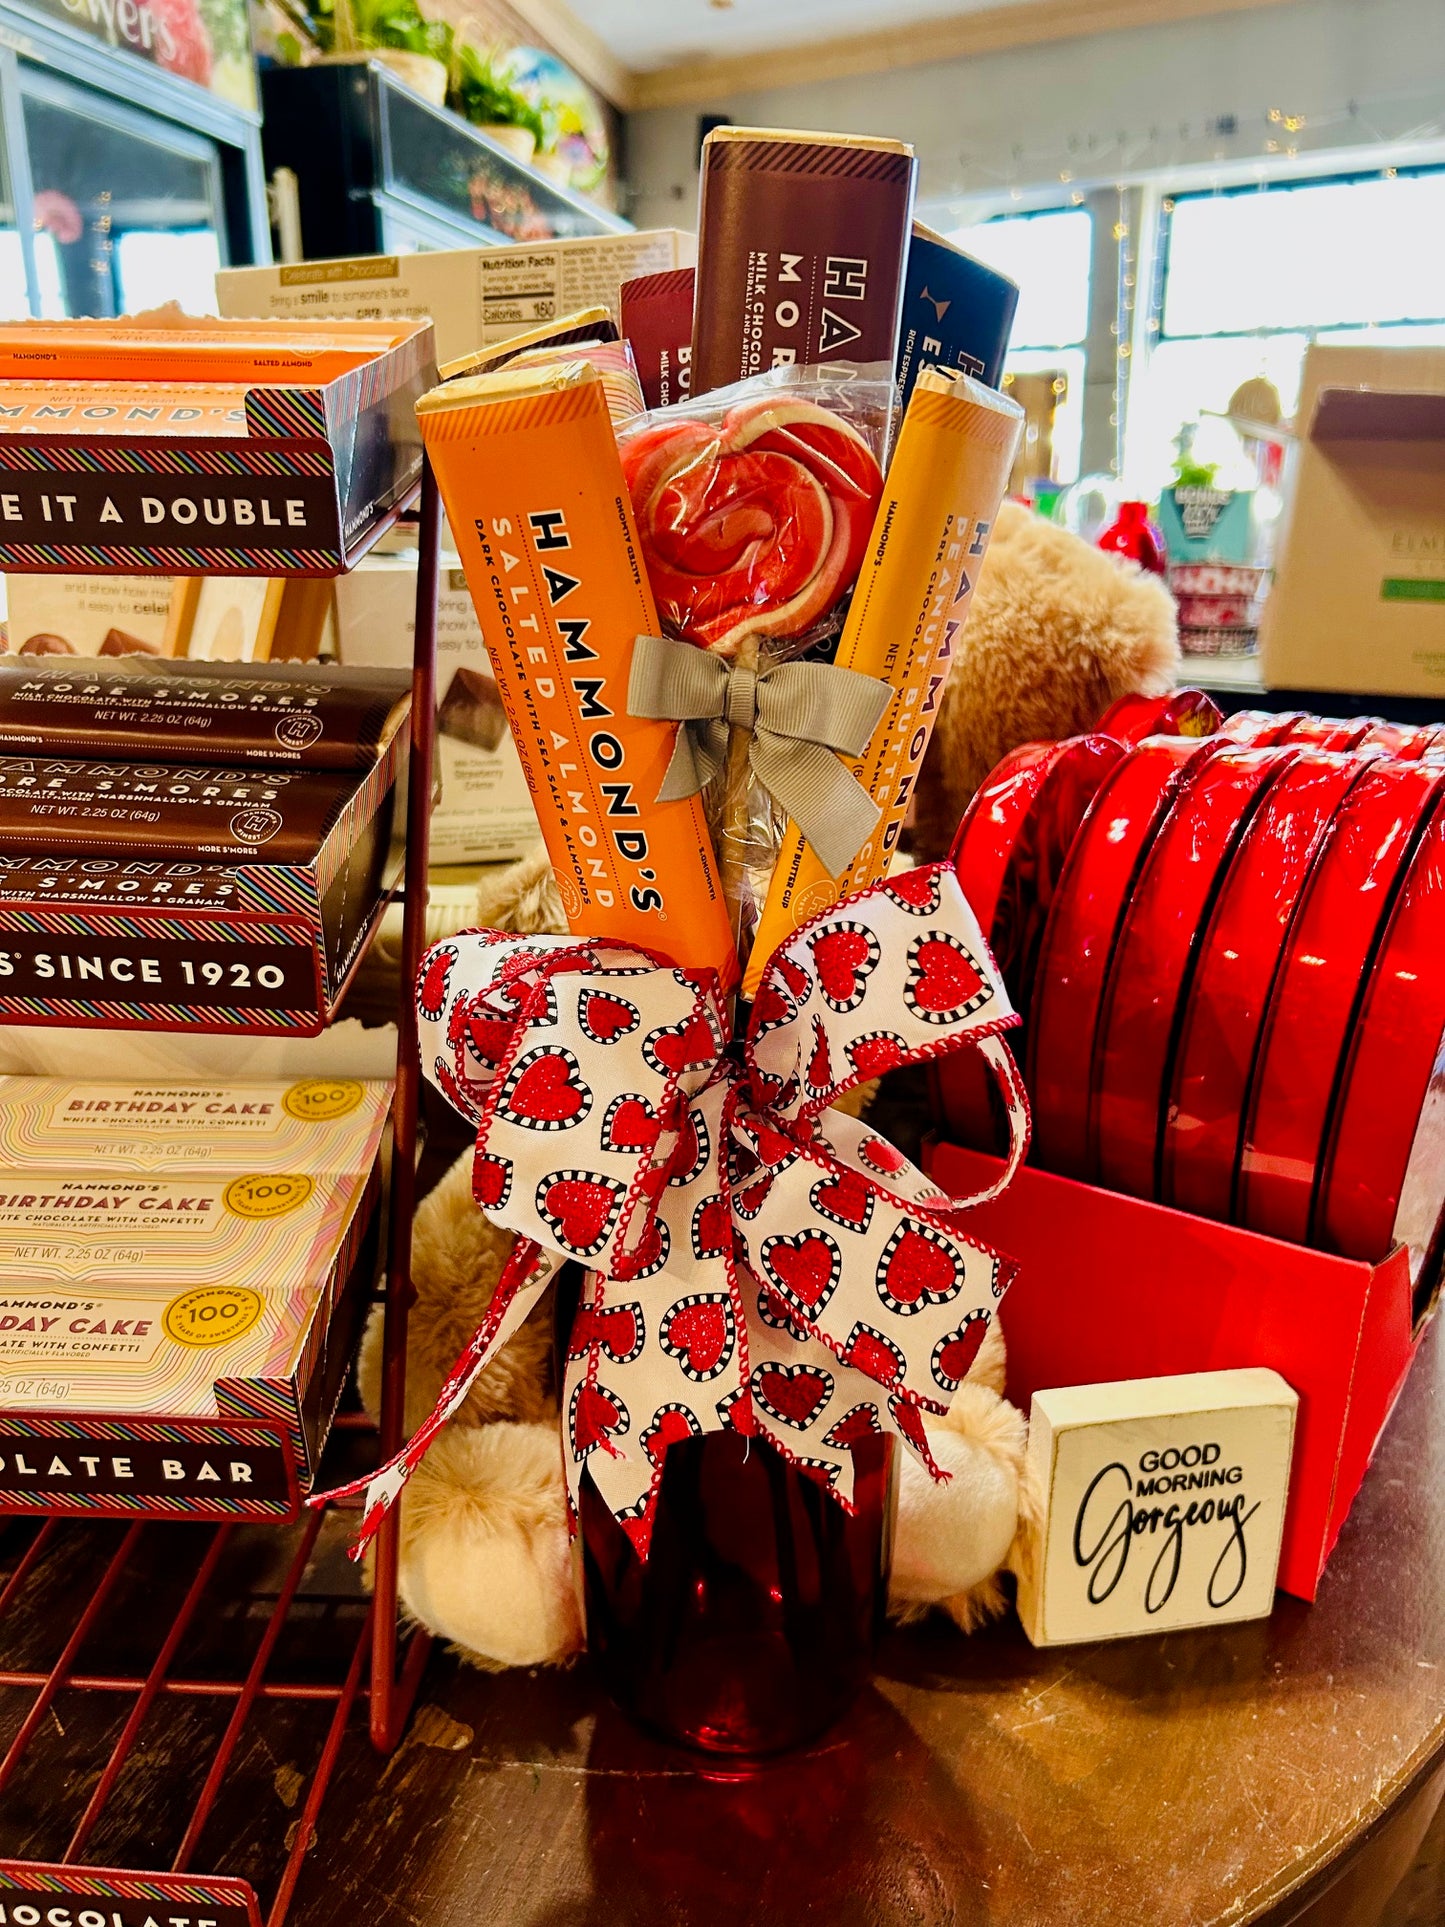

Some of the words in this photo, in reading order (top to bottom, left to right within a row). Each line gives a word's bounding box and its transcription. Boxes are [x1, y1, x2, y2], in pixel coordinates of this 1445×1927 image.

[745, 251, 756, 310] NATURALLY
[754, 252, 768, 295] MILK
[300, 290, 329, 303] smile
[772, 253, 804, 370] MOR
[748, 302, 765, 375] CHOCOL
[904, 329, 916, 353] RICH
[12, 352, 57, 360] HAMMOND'S
[253, 359, 280, 367] SALTED
[660, 350, 669, 379] MILK
[660, 381, 669, 407] CHO
[0, 405, 245, 423] MMOND'S
[1, 494, 23, 521] E
[40, 495, 77, 522] IT
[100, 496, 123, 522] A
[141, 497, 307, 526] DOUBLE
[615, 496, 631, 543] ALMOND
[874, 501, 898, 567] HAMMOND'S
[935, 514, 954, 562] DARK
[627, 546, 640, 585] SALTED
[917, 516, 968, 668] PEANUT
[902, 571, 937, 679] CHOCOLATE
[489, 646, 504, 675] NET
[884, 643, 899, 672] NET
[21, 682, 128, 697] MORE
[154, 689, 320, 707] S'MORES
[95, 710, 117, 720] NET
[119, 712, 137, 722] WT.
[140, 713, 164, 723] 2.25
[166, 715, 183, 724] OZ
[184, 715, 212, 728] (64g)
[154, 701, 247, 710] MARSHMALLOW
[263, 706, 312, 714] GRAHAM
[474, 519, 495, 566] DARK
[490, 575, 528, 681] CHOCOLATE
[522, 688, 541, 730] WITH
[536, 738, 551, 768] SEA
[547, 774, 565, 811] SALT
[559, 817, 569, 827] &
[564, 833, 592, 905] ALMONDS
[492, 517, 556, 699] SALTED
[549, 729, 615, 907] ALMOND
[527, 508, 664, 912] HAMMOND'S
[887, 687, 904, 730] WITH
[269, 751, 301, 759] S'MORES
[877, 687, 918, 802] BUTTE
[0, 787, 57, 796] OCOLATE
[98, 793, 199, 804] MARSHMALLOW
[216, 800, 271, 809] GRAHAM
[96, 780, 278, 800] S'MORES
[30, 805, 55, 814] NET
[57, 806, 78, 816] WT.
[81, 807, 107, 817] 2.25
[111, 809, 128, 819] OZ
[129, 810, 161, 822] (64g)
[222, 847, 257, 855] S'MORES
[0, 857, 236, 878] MMOND'S
[786, 854, 802, 888] BUTTER
[853, 842, 873, 885] CU
[38, 877, 235, 895] S'MORES
[39, 891, 148, 902] MARSHMALLOW
[166, 897, 225, 906] GRAHAM
[782, 889, 792, 909] CUP
[34, 953, 162, 983] SINCE
[181, 961, 285, 989] 1920
[68, 1100, 198, 1113] BIRTHDAY
[204, 1102, 275, 1115] CAKE
[303, 1089, 345, 1105] 100
[209, 1119, 267, 1127] CONFETTI
[61, 1183, 160, 1192] HAMMOND'S
[247, 1183, 292, 1200] 100
[138, 1197, 215, 1211] CAKE
[25, 1214, 101, 1222] CHOCOLATE
[142, 1217, 205, 1225] CONFETTI
[14, 1247, 38, 1258] NET
[41, 1247, 62, 1259] WT.
[65, 1248, 91, 1260] 2.25
[94, 1249, 111, 1260] OZ
[113, 1249, 144, 1263] (64g)
[0, 1300, 95, 1311] AMMOND'S
[180, 1290, 249, 1310] HAMMOND'S
[189, 1303, 239, 1323] 100
[0, 1315, 61, 1332] DAY
[69, 1317, 153, 1336] CAKE
[0, 1340, 26, 1348] ATE
[32, 1341, 67, 1350] WITH
[72, 1342, 140, 1353] CONFETTI
[15, 1381, 33, 1394] OZ
[36, 1382, 71, 1399] (64g)
[0, 1453, 134, 1478] LATE
[162, 1459, 253, 1483] BAR
[1139, 1443, 1221, 1473] GOOD
[1136, 1466, 1243, 1497] MORNING
[1073, 1462, 1261, 1614] Gorgeous
